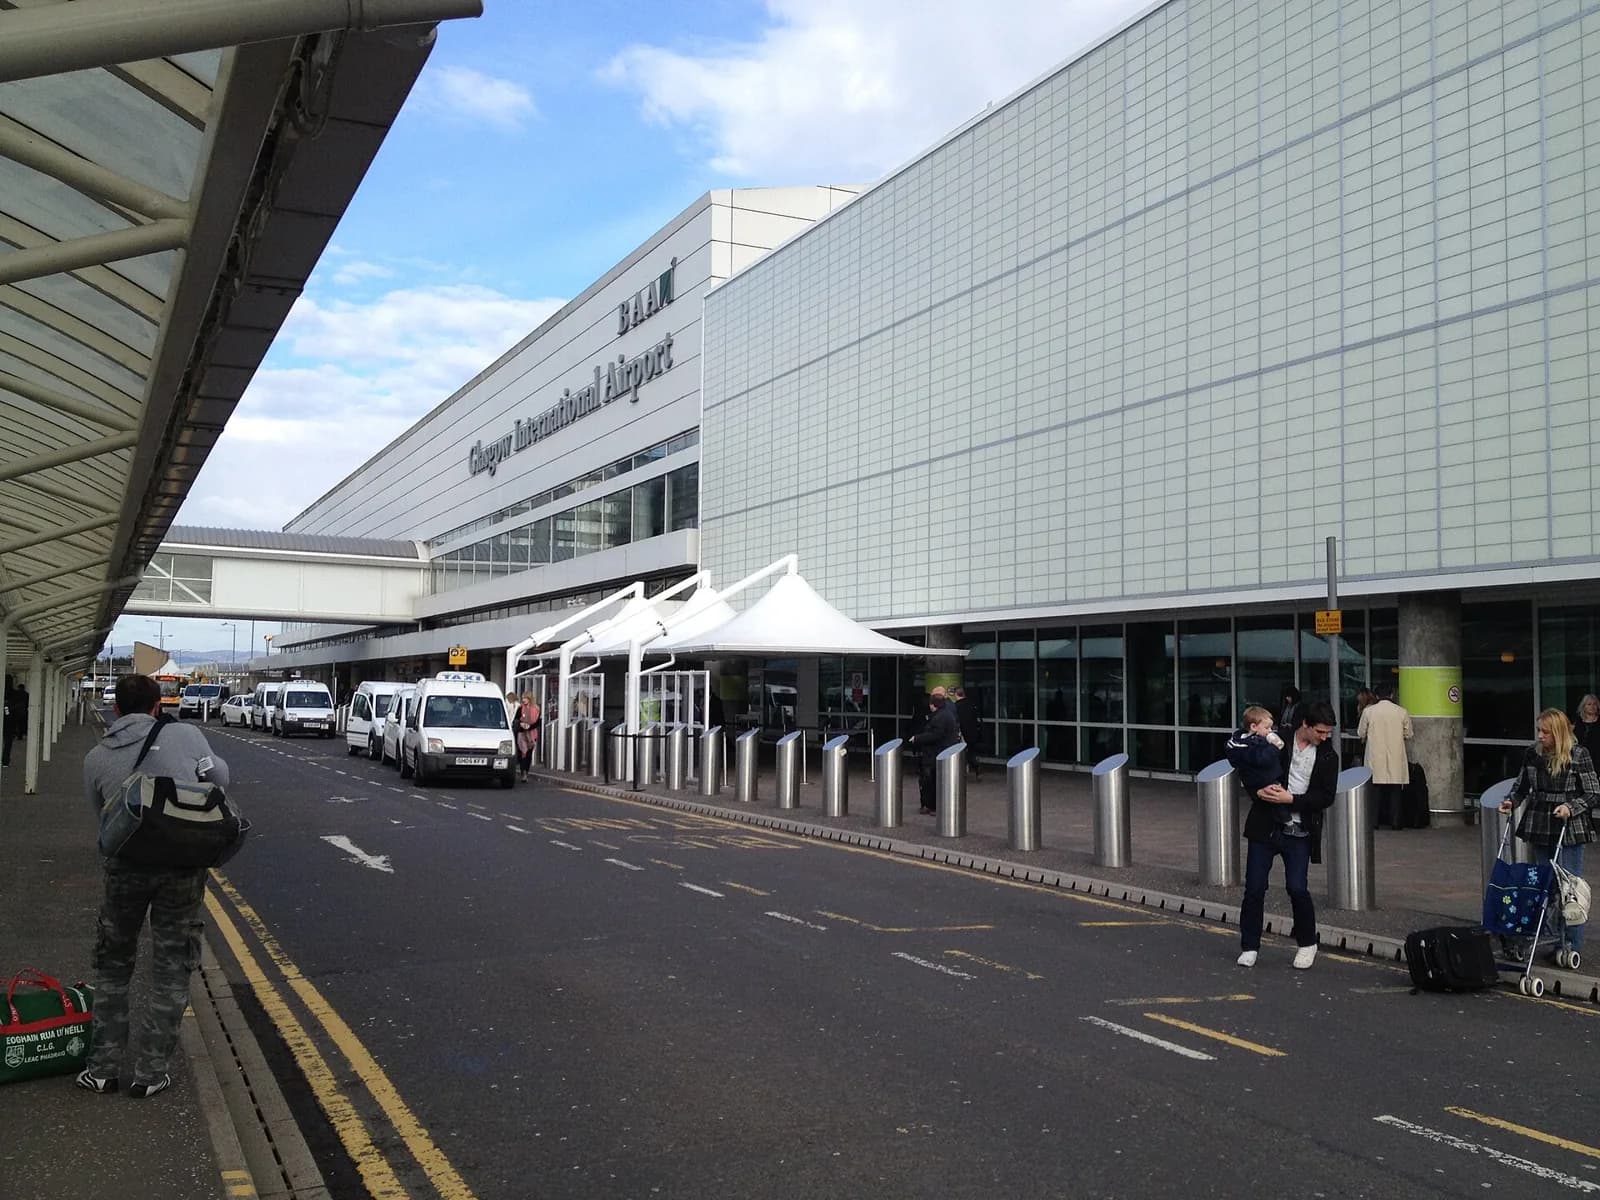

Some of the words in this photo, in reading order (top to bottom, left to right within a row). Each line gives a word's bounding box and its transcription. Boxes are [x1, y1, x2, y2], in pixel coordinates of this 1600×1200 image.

[617, 281, 660, 336] BAA
[469, 434, 512, 477] Glasgow
[513, 366, 602, 452] International
[602, 332, 674, 403] Airport
[459, 648, 466, 657] 2
[6, 1033, 39, 1045] EOGHAIN
[40, 1030, 56, 1041] RUA
